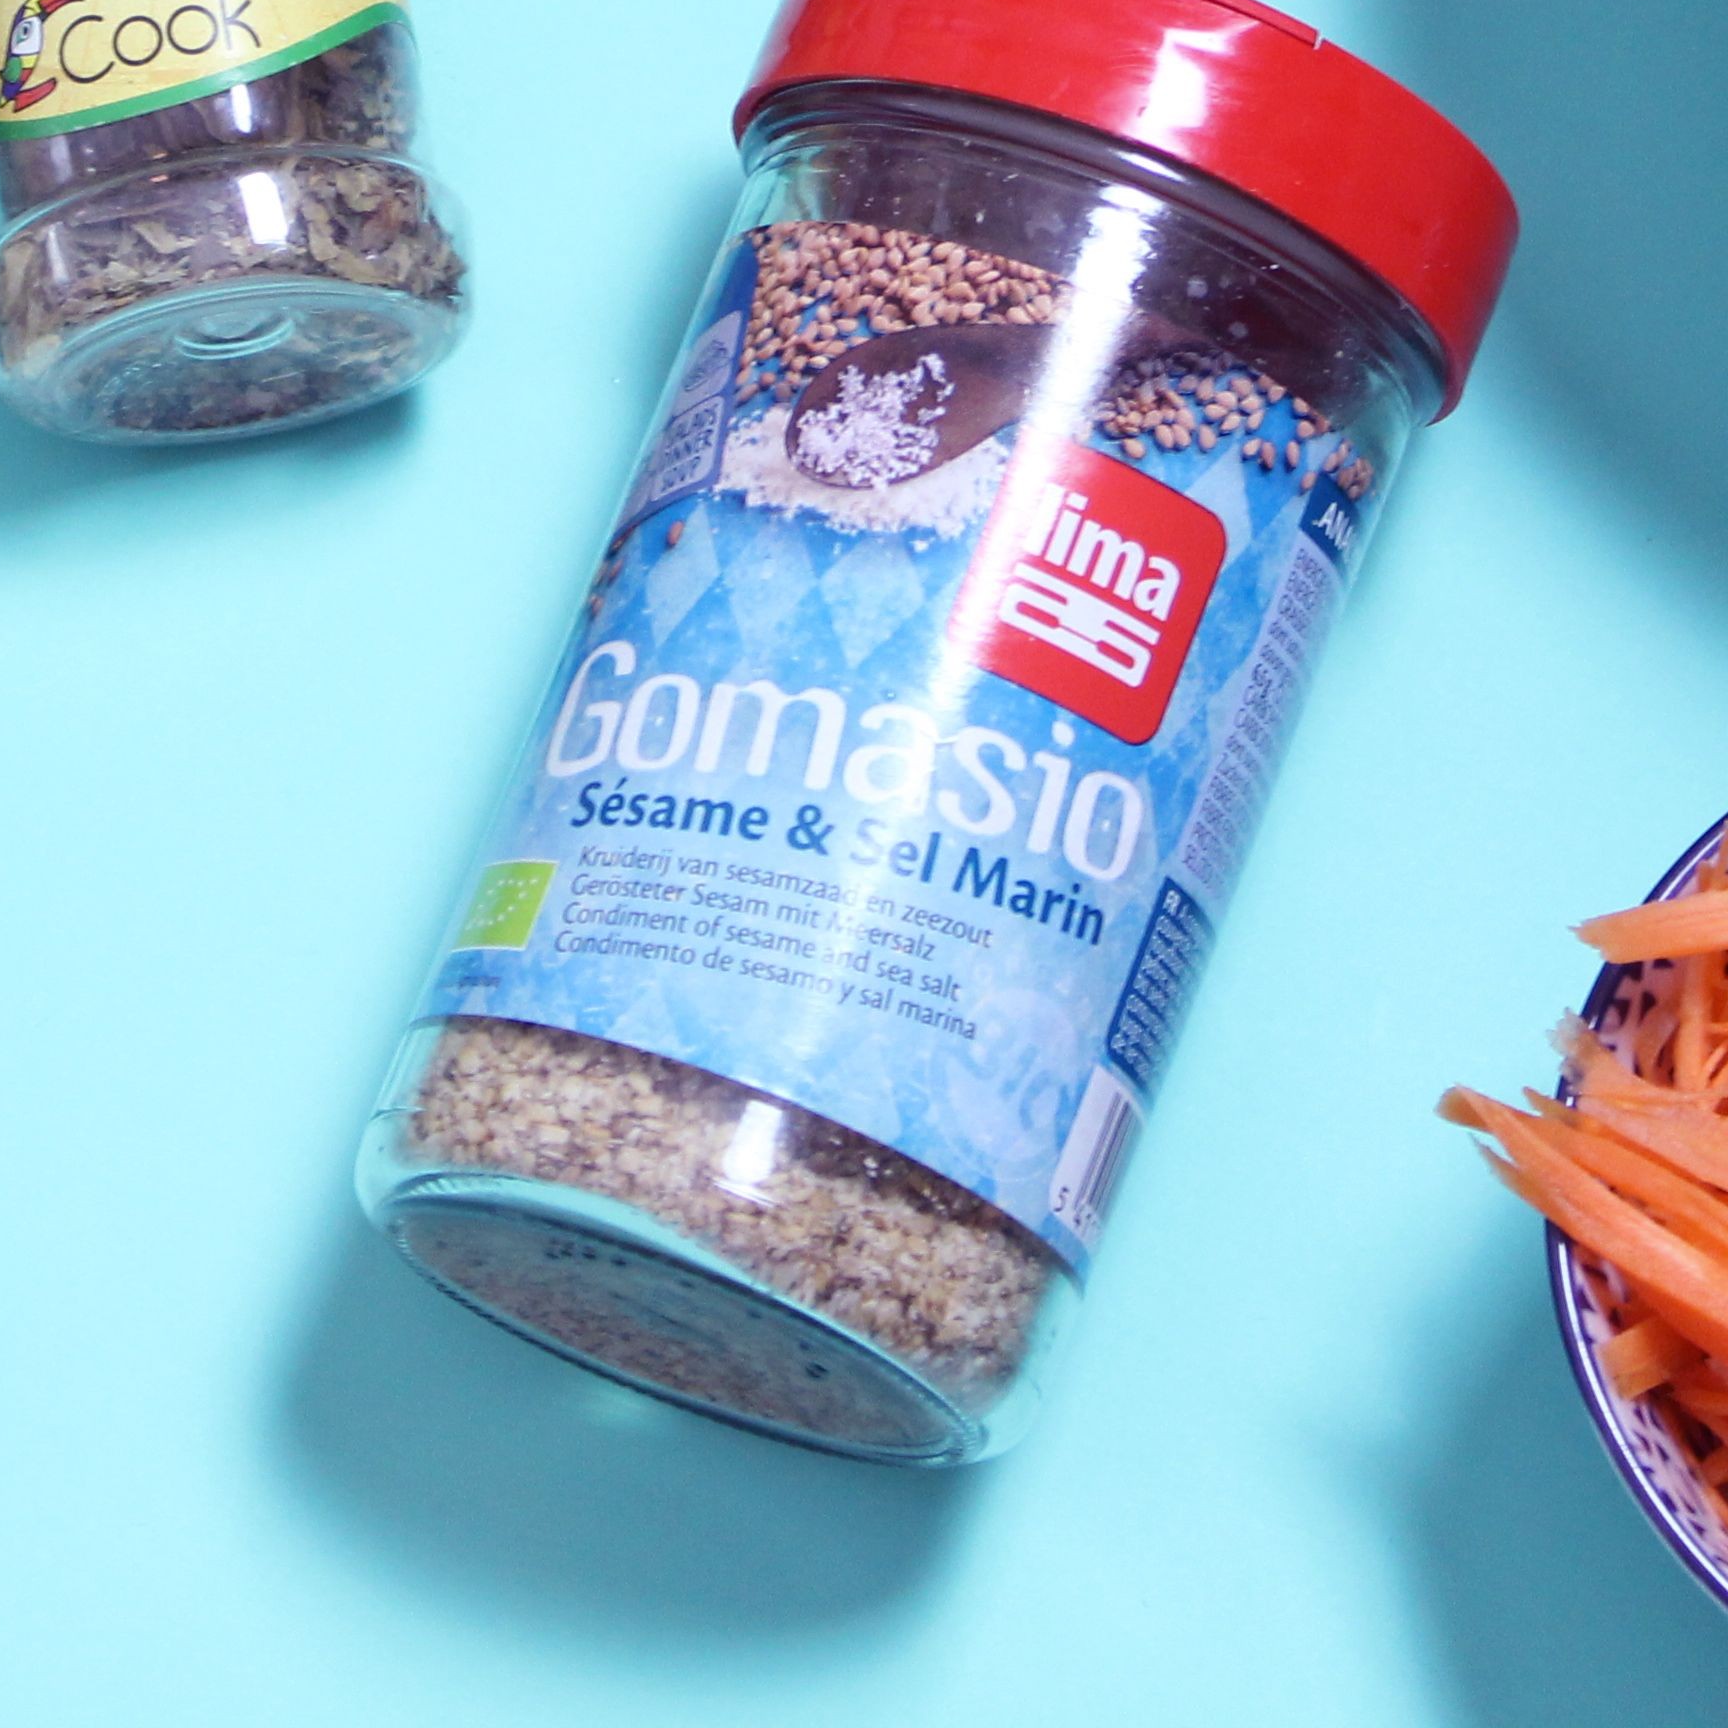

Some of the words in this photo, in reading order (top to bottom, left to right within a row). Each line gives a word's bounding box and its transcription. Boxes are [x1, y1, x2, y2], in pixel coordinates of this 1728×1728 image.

[1022, 482, 1181, 622] lima
[546, 640, 1144, 881] Gomasio
[571, 776, 769, 840] Sésame
[785, 804, 835, 856] &
[849, 817, 941, 883] Sel
[953, 847, 1103, 945] Marin
[571, 873, 687, 901] Gerösteter
[690, 883, 769, 916] Sesam
[776, 903, 820, 929] mit
[578, 845, 671, 877] Kruiderij
[678, 856, 719, 877] van
[725, 863, 859, 906] sesamzaad
[867, 895, 894, 917] en
[901, 904, 993, 949] zeezout
[554, 930, 696, 965] Condimento
[703, 947, 734, 972] de
[740, 958, 833, 994] sesamo
[838, 983, 856, 1005] y
[858, 988, 893, 1012] sal
[897, 1000, 978, 1040] marina
[562, 901, 688, 933] Condiment
[693, 915, 724, 937] of
[725, 925, 817, 959] sesame
[821, 947, 871, 972] and
[875, 962, 913, 986] sea
[919, 975, 961, 1002] salt
